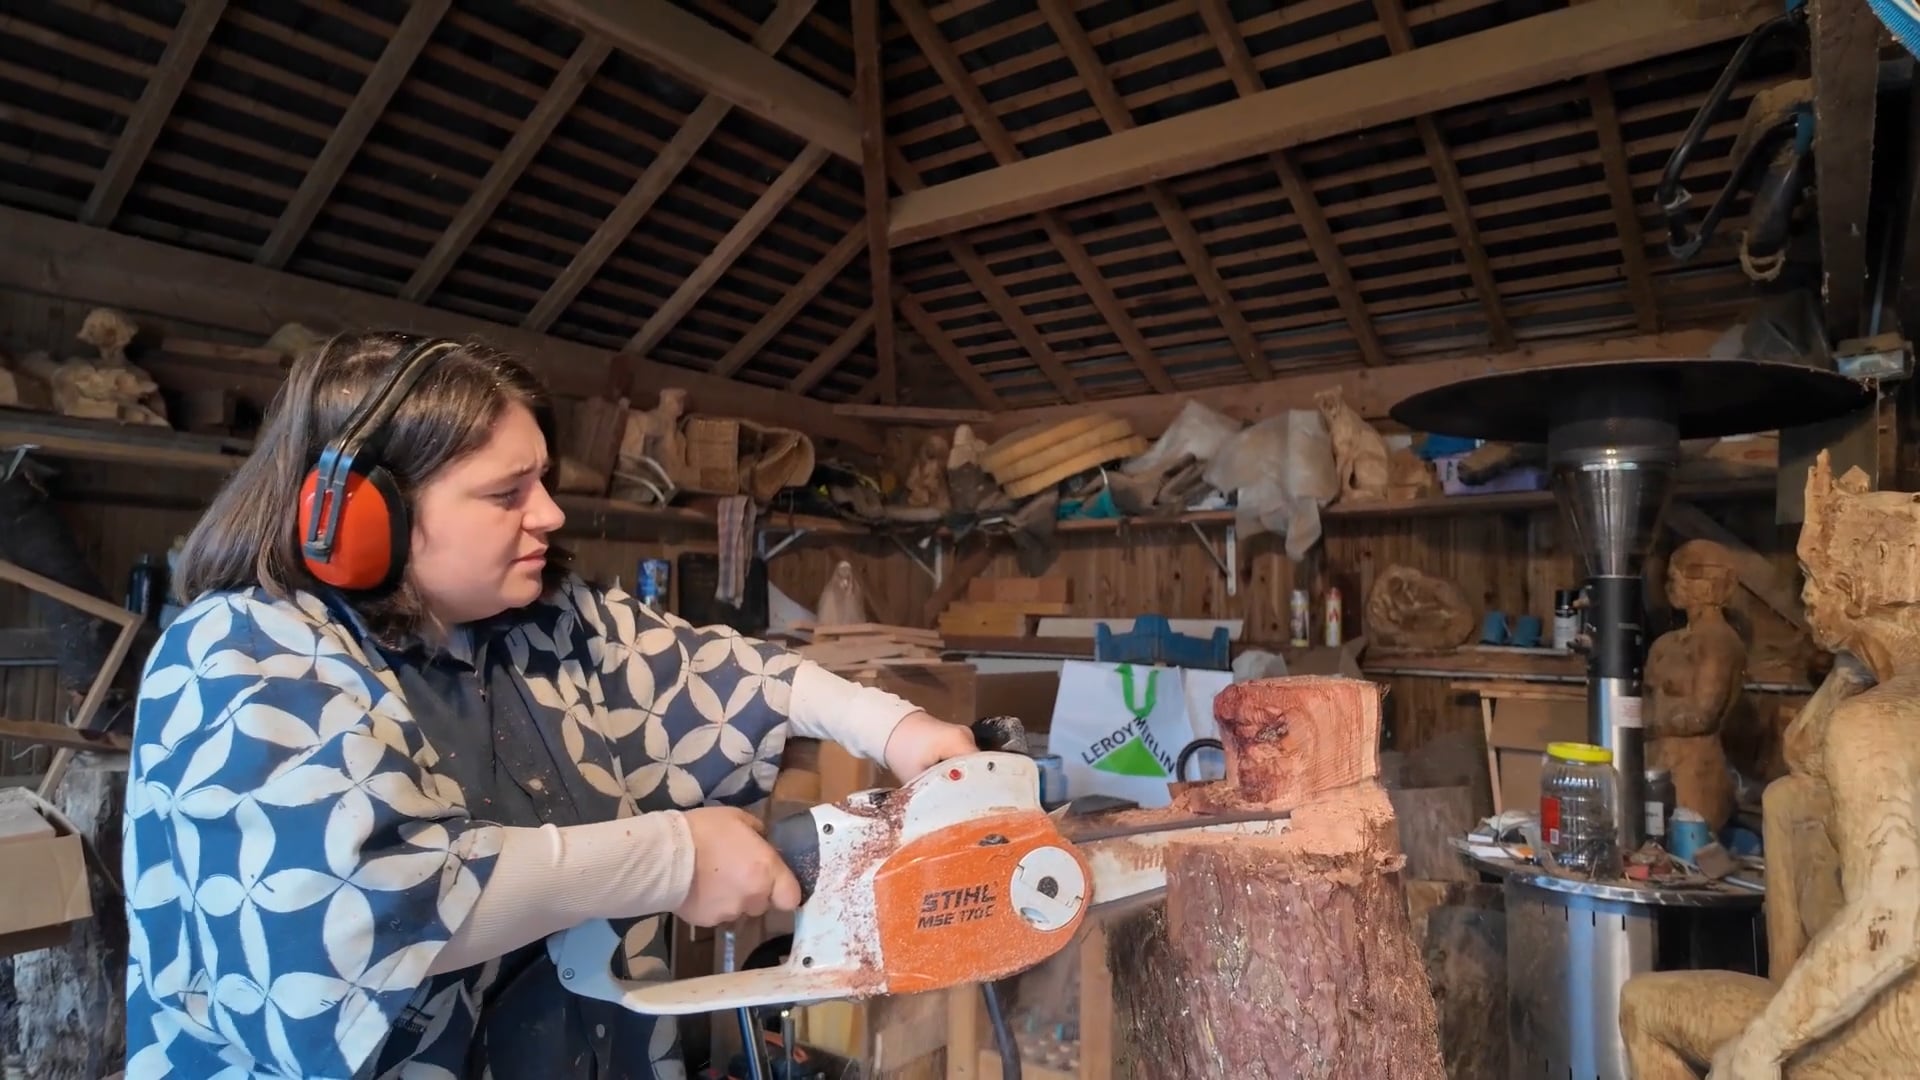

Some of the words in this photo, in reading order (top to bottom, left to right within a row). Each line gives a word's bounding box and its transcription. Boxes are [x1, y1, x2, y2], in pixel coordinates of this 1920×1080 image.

[1081, 722, 1134, 765] LEROY
[1133, 715, 1176, 774] MERLIN
[920, 884, 997, 913] STIHL
[917, 912, 955, 929] MSE
